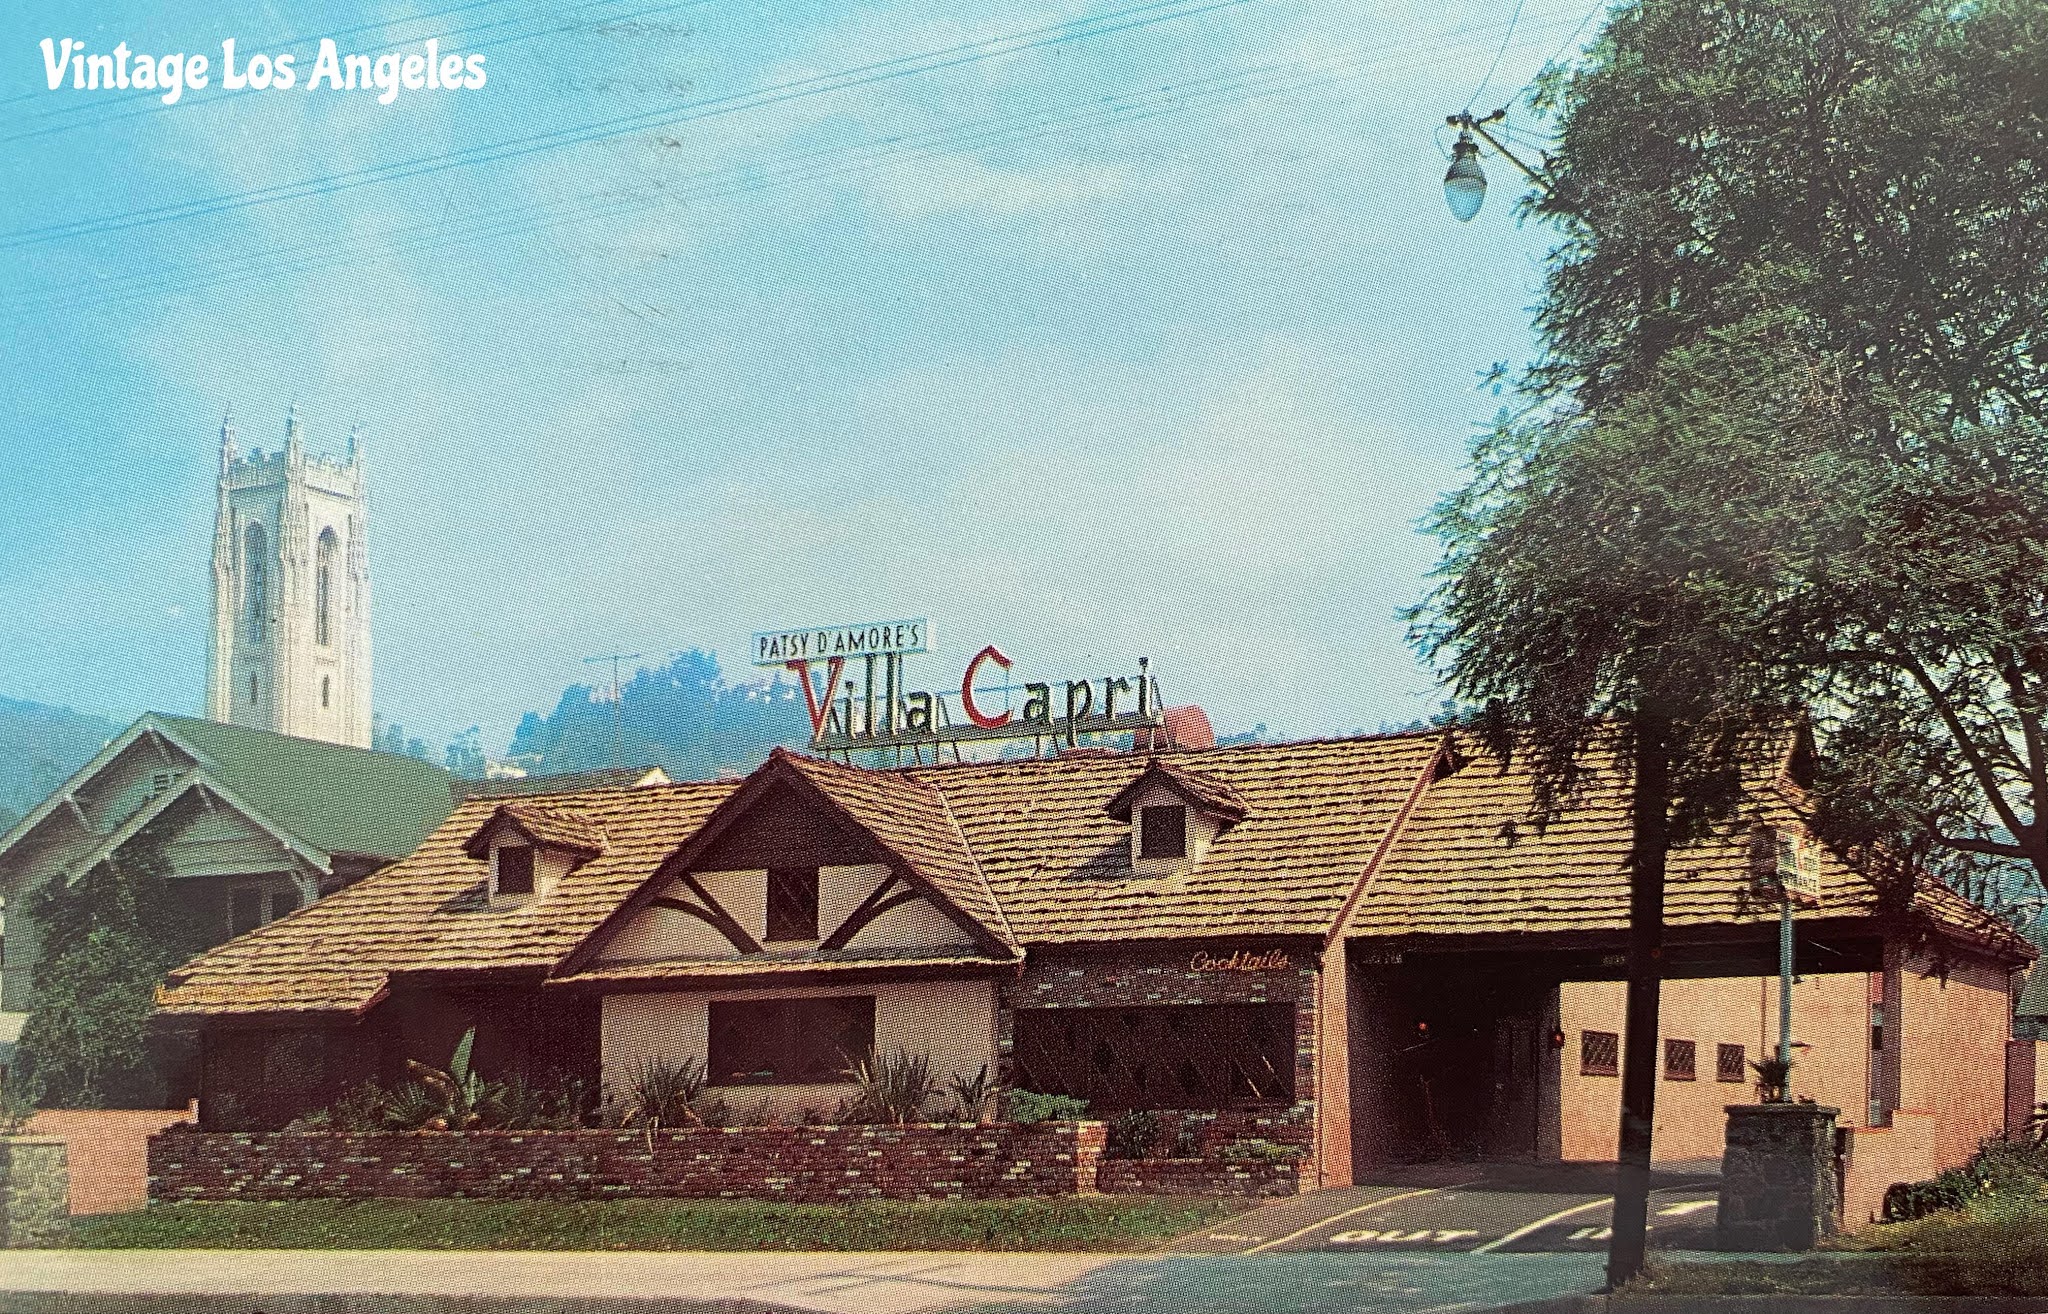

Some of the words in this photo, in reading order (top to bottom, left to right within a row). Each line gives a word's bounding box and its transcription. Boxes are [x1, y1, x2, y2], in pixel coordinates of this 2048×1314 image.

[759, 631, 809, 659] PATSY
[818, 623, 919, 653] D'AMORE'S
[785, 653, 938, 740] Villa
[961, 645, 1149, 748] Capri
[1190, 948, 1290, 972] Cocktails
[1329, 1229, 1480, 1243] OUT
